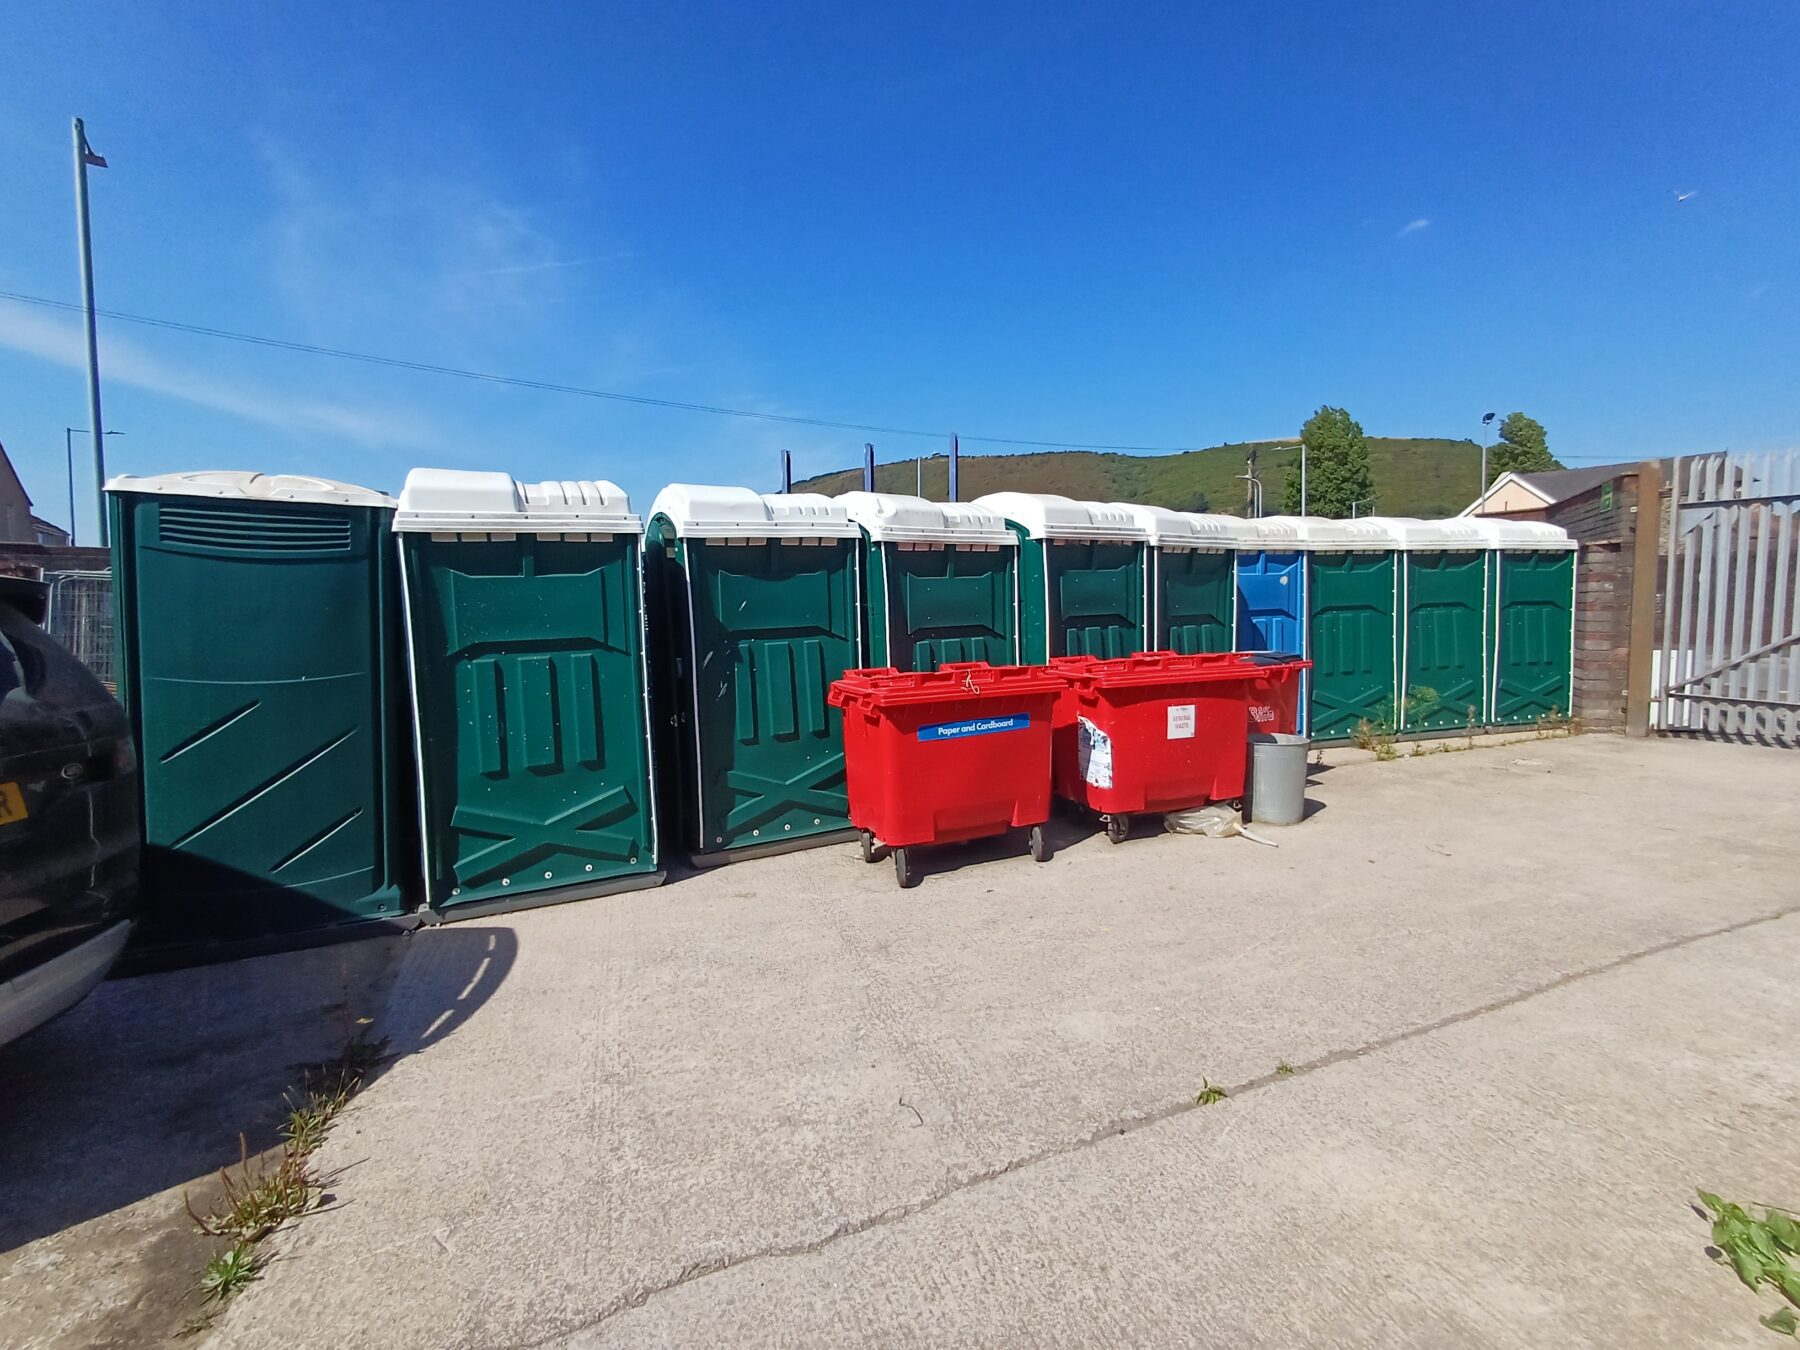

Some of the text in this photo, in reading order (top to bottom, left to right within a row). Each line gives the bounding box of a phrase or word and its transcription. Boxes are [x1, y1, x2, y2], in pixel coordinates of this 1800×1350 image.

[937, 718, 1014, 736] Paper and Cardboard
